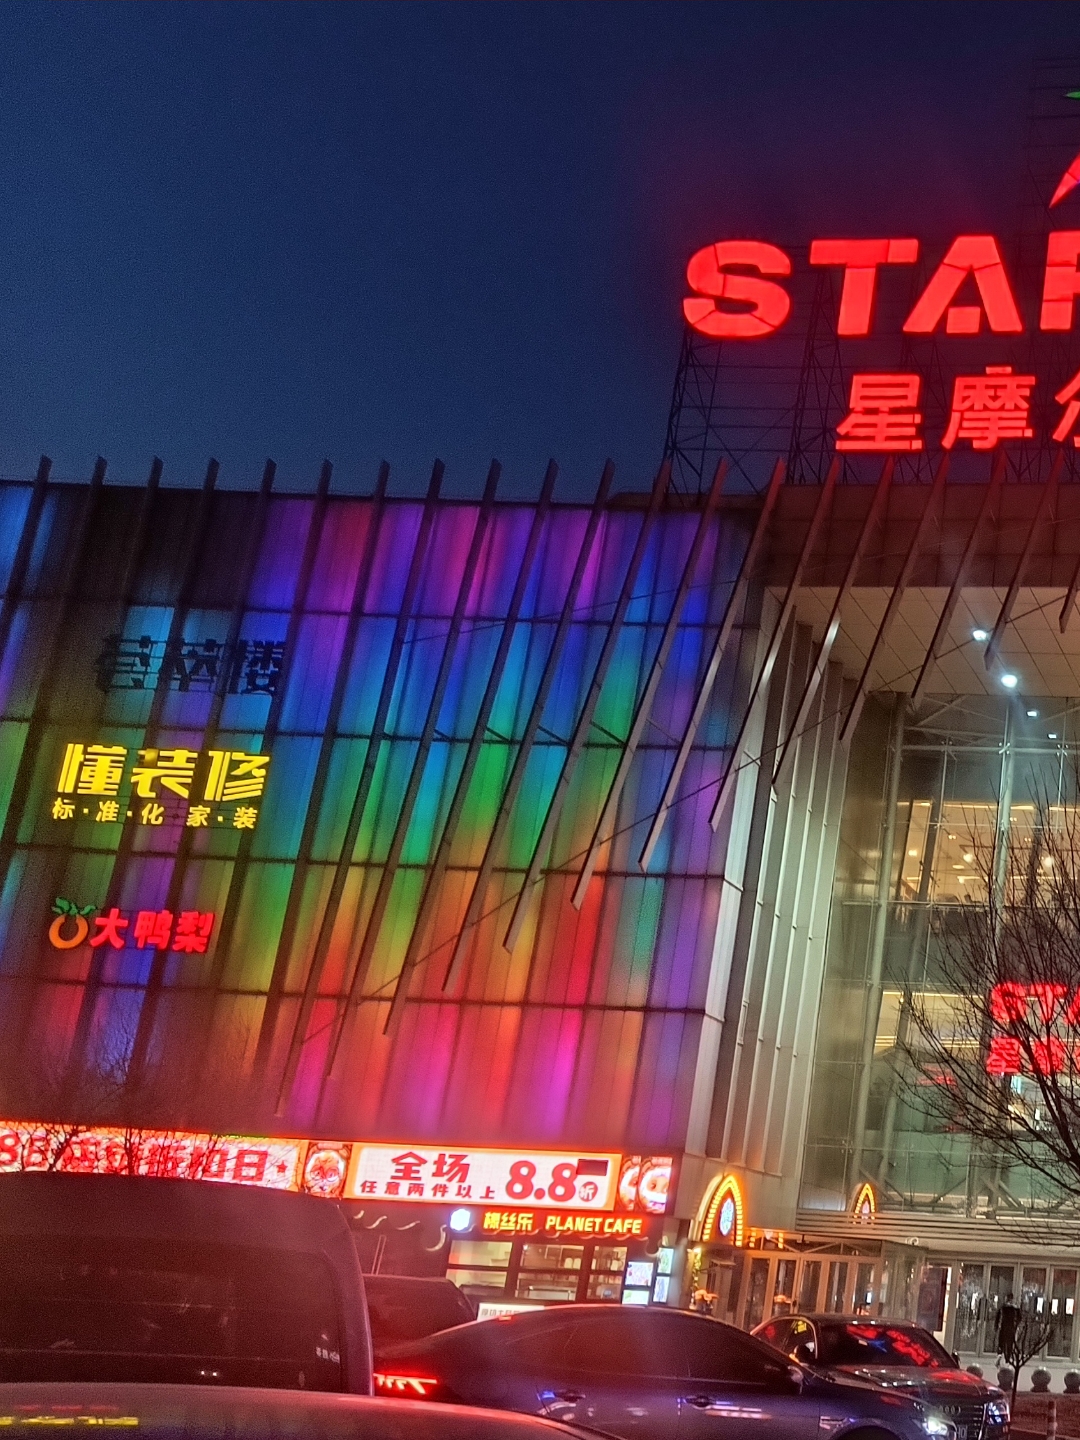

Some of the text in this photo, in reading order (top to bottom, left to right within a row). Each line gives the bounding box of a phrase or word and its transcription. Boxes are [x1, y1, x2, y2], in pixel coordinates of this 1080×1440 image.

[57, 743, 270, 801] 懂装修
[89, 908, 214, 953] 大鸭梨
[391, 1151, 471, 1184] 全场
[360, 1180, 496, 1200] 任意两件以上
[545, 1215, 602, 1232] PLANET
[603, 1218, 643, 1234] CAFE
